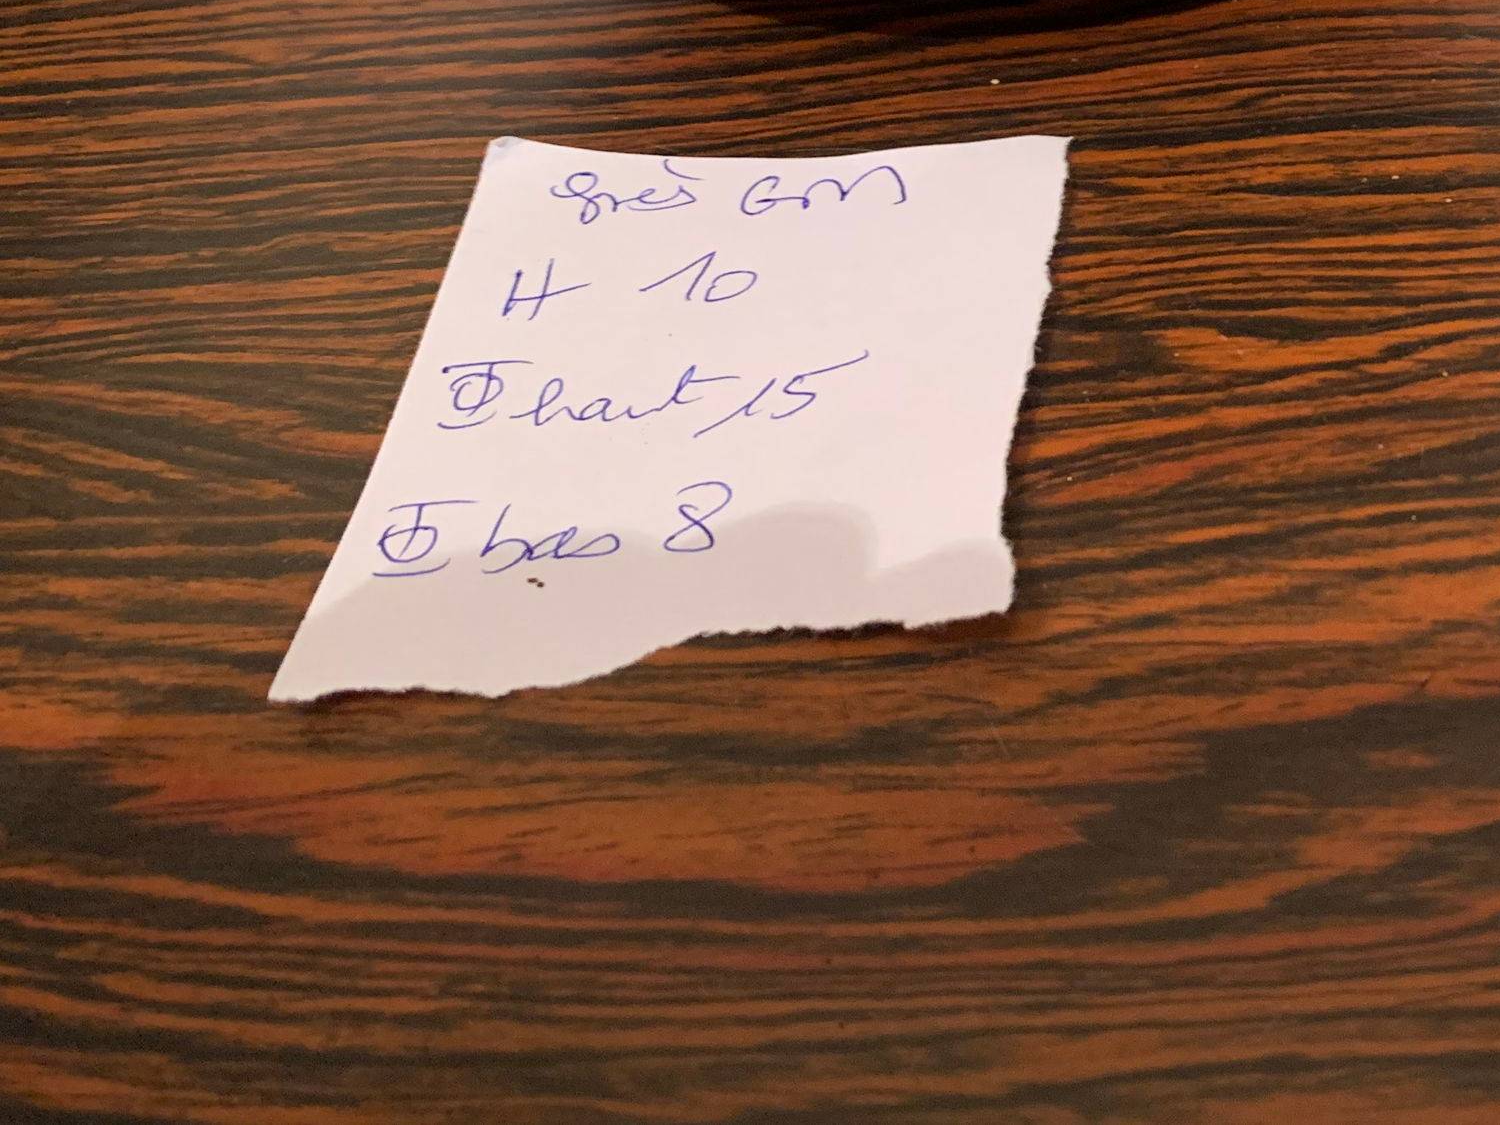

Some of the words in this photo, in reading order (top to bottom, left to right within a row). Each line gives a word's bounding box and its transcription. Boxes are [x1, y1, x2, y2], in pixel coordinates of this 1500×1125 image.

[501, 257, 592, 321] H
[638, 250, 758, 303] 10
[692, 349, 870, 439] 15
[663, 480, 733, 553] 8
